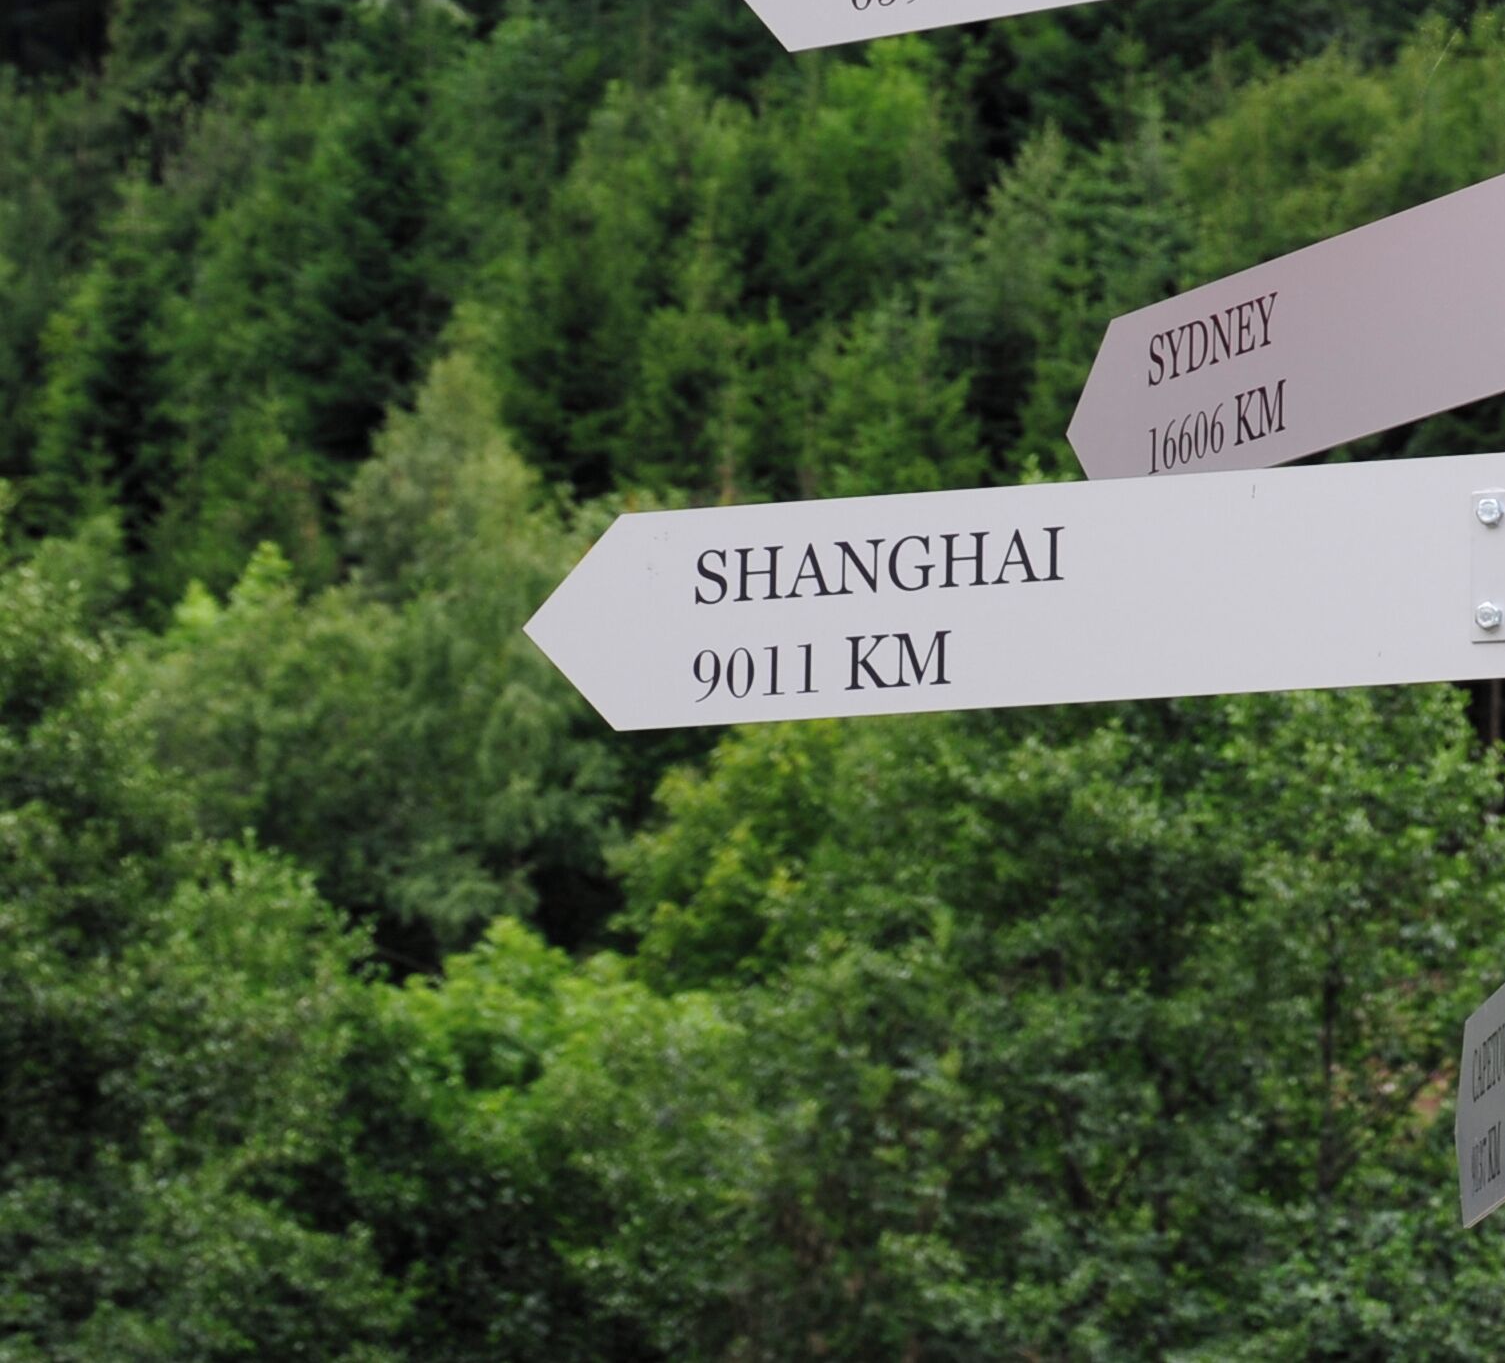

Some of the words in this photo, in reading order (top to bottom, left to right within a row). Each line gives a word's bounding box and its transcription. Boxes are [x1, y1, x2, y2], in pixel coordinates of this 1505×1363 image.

[1149, 292, 1277, 386] SYDNEY
[1149, 403, 1224, 475] 16606
[1234, 379, 1286, 446] KM
[695, 527, 1064, 604] SHANGHAI
[693, 644, 818, 702] 9011
[845, 631, 951, 690] KM
